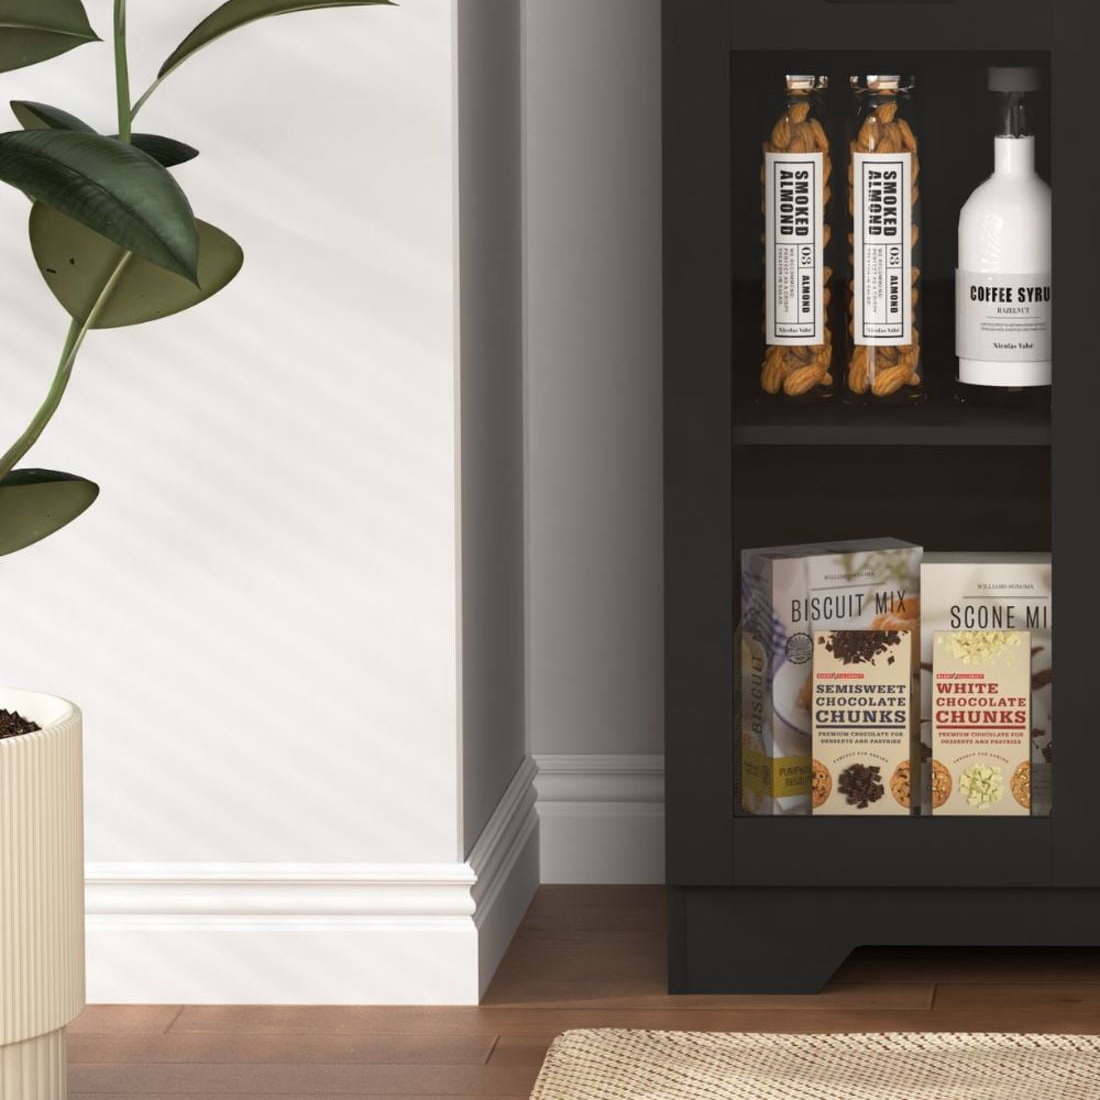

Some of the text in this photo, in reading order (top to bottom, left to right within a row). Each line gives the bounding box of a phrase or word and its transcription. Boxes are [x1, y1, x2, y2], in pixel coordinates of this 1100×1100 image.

[780, 170, 794, 236] ALMOND
[795, 170, 809, 237] SMOKED
[868, 170, 882, 236] ALMOND
[883, 170, 897, 237] SMOKED
[801, 247, 812, 265] 03
[890, 247, 900, 265] 03
[802, 275, 810, 313] ALMOND
[890, 275, 898, 313] ALMOND
[970, 286, 1012, 302] COFFEE
[791, 590, 906, 622] BISCUIT MIX
[951, 605, 1015, 629] SCONE
[816, 685, 906, 693] SEMISWEET
[937, 683, 998, 694] WHITE
[816, 697, 905, 706] CHOCOLATE
[936, 698, 1026, 707] CHOCOLATE
[816, 710, 905, 723] CHUNKS
[936, 711, 1026, 723] CHUNKS
